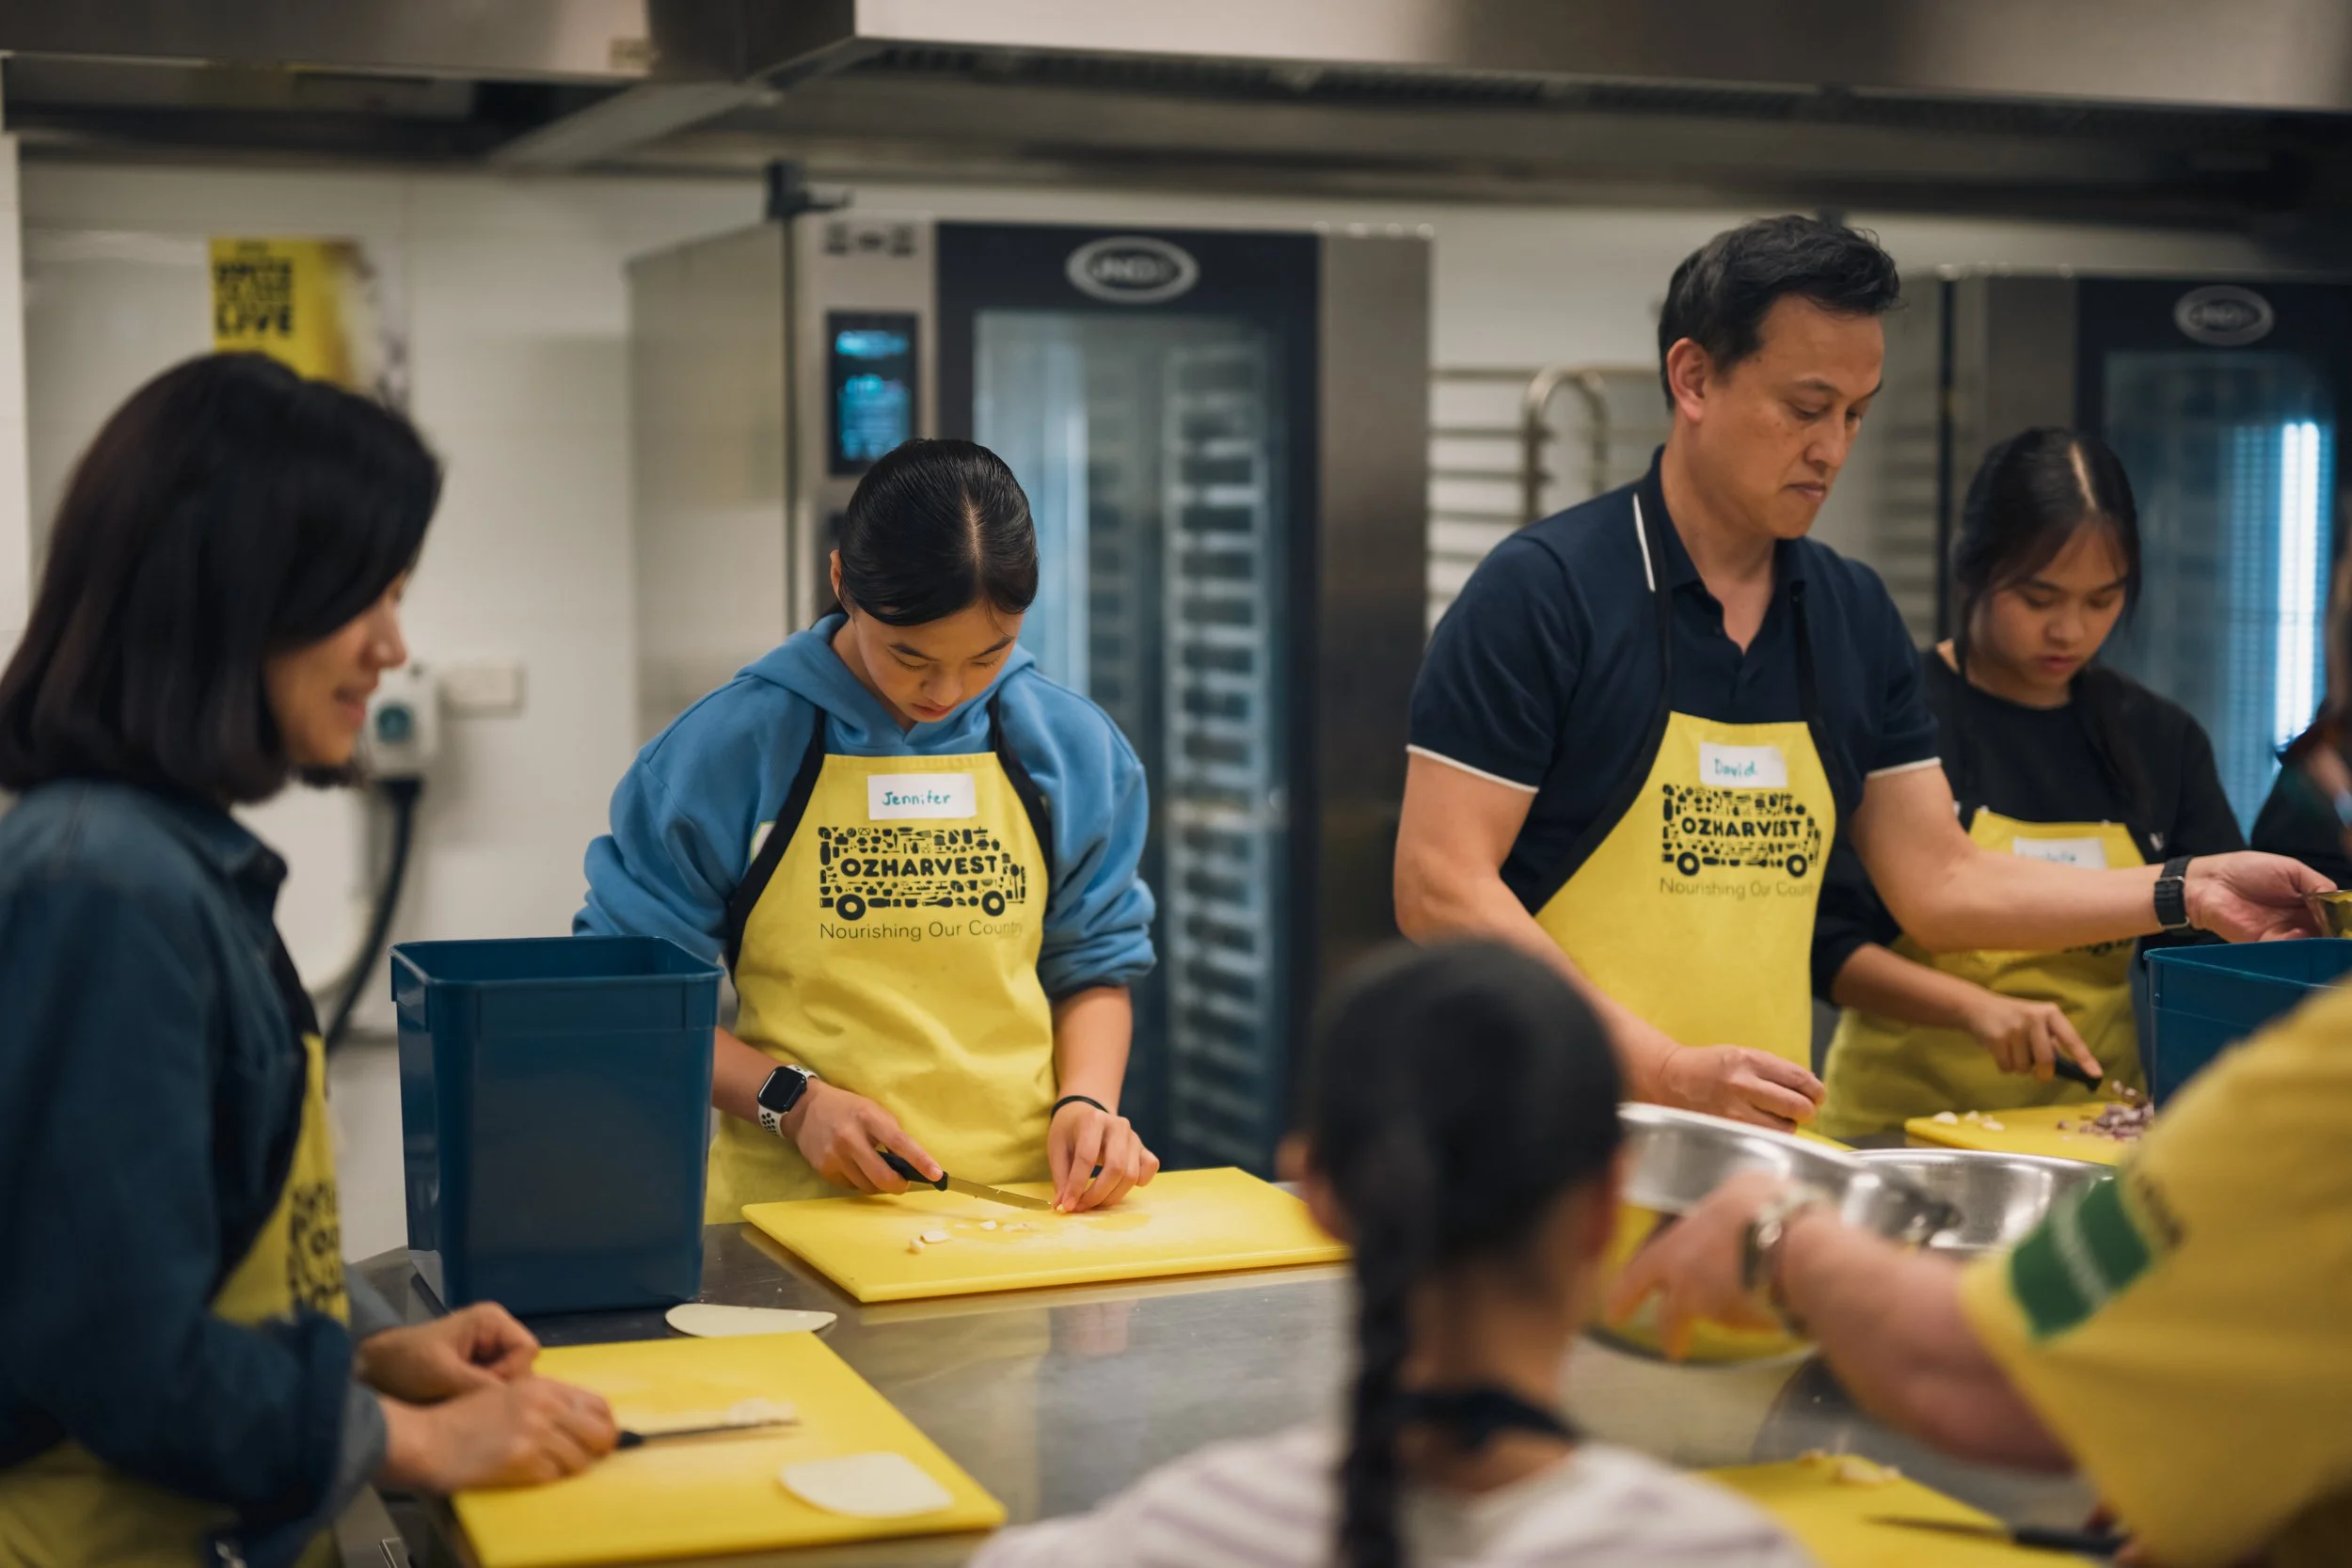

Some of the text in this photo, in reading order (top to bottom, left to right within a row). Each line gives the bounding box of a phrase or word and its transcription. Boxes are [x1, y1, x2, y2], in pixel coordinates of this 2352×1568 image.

[882, 790, 951, 806] Jennifer
[840, 855, 997, 878] OZHARVEST
[819, 920, 1024, 942] Nourishing Our County
